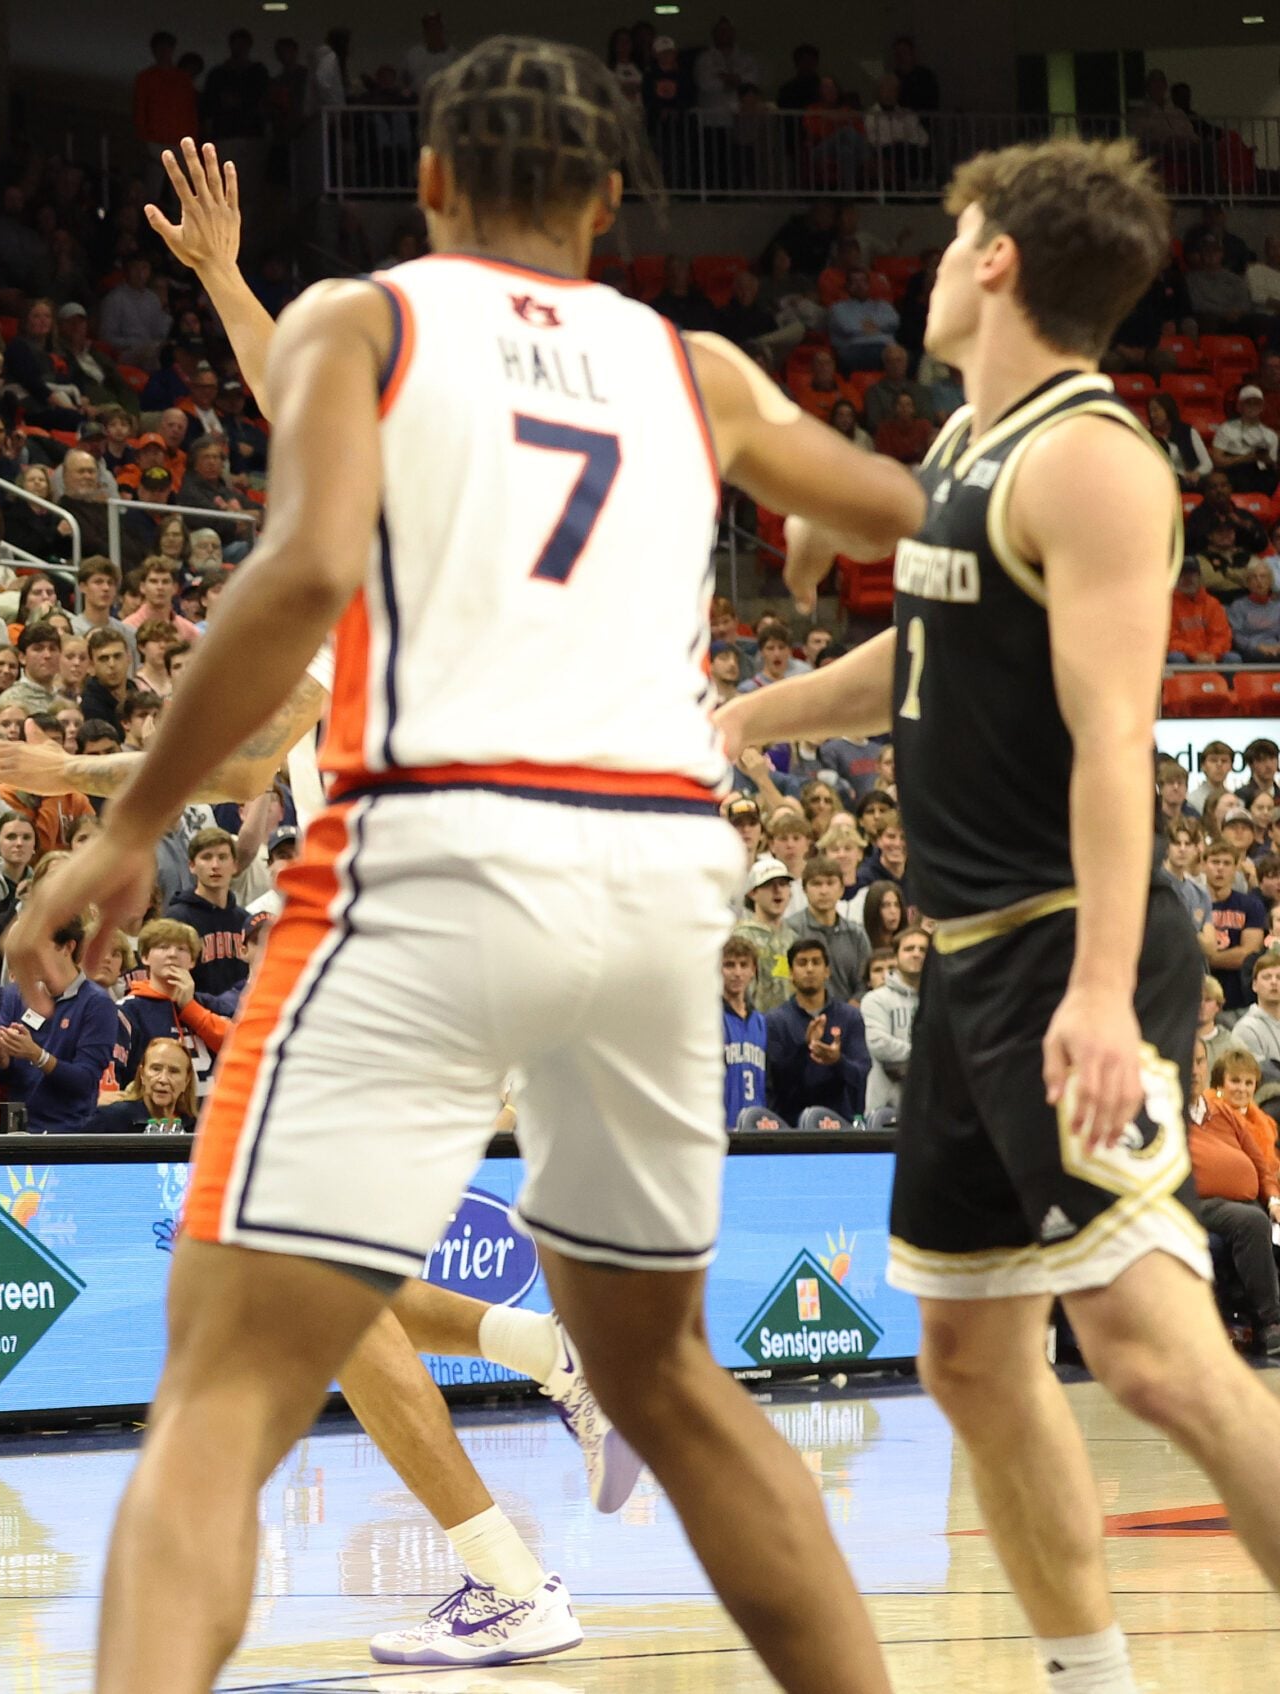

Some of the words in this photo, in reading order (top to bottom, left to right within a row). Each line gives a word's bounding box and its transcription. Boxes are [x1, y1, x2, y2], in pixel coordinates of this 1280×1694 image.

[496, 335, 608, 404] HALL
[512, 409, 622, 585] 7
[743, 1070, 755, 1101] 3
[422, 1224, 515, 1281] rrier
[760, 1325, 863, 1364] Sensigreen
